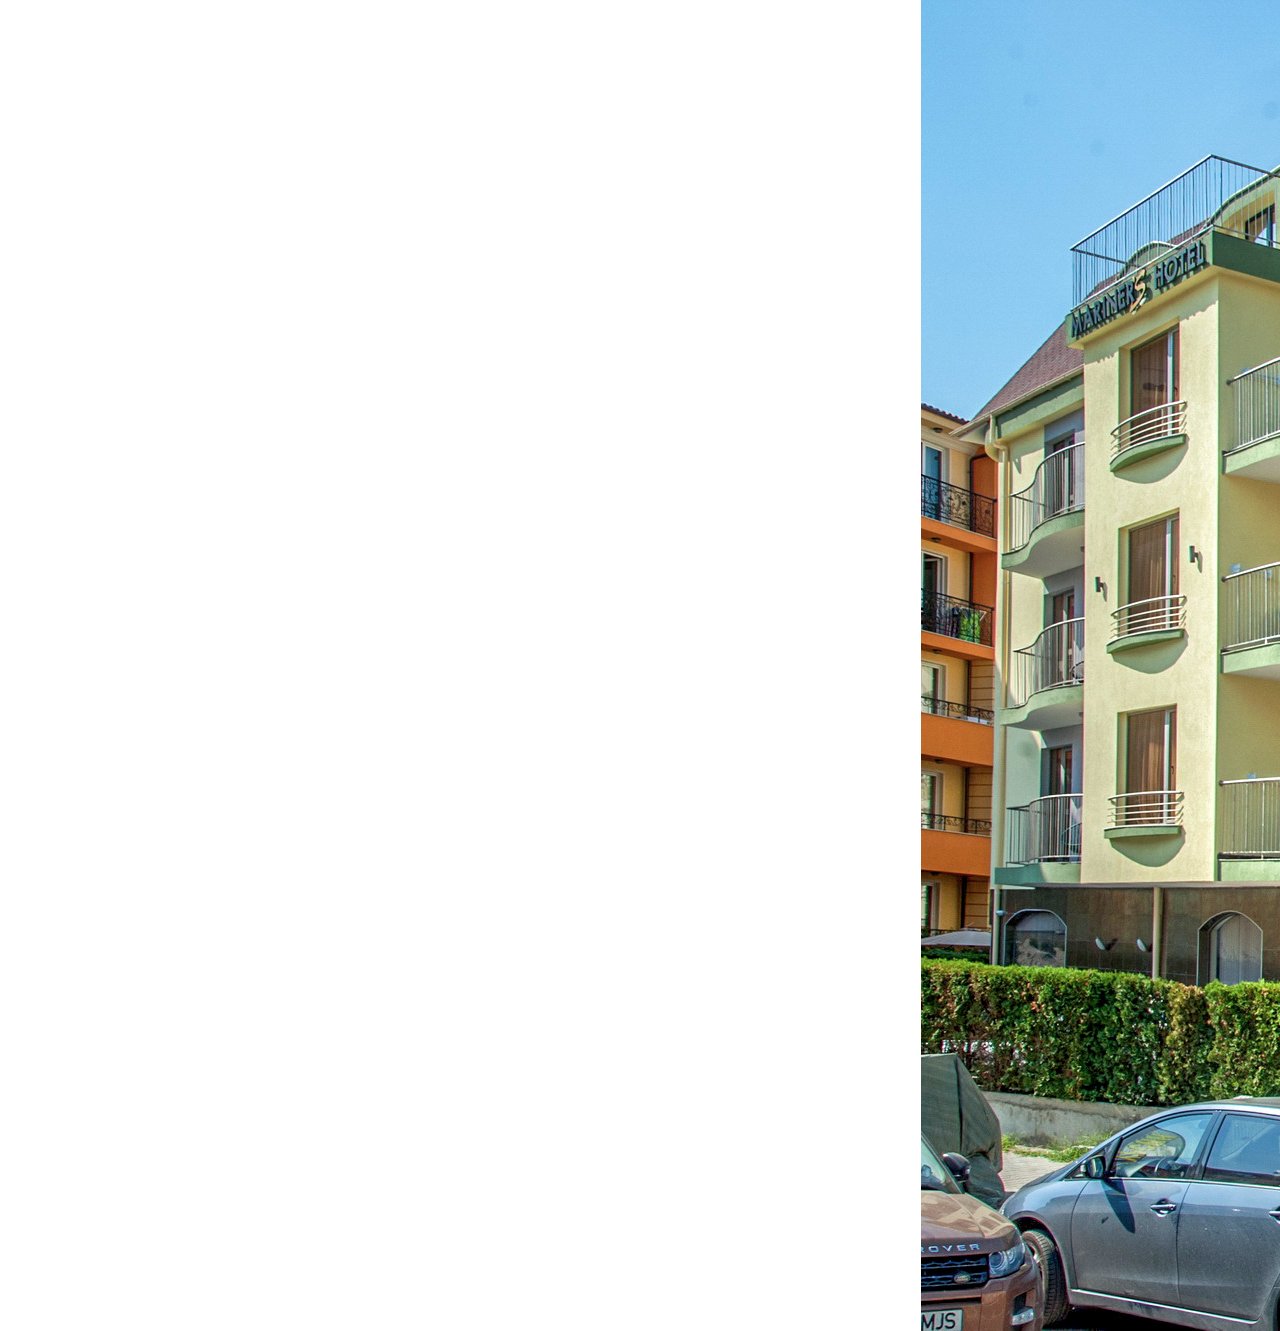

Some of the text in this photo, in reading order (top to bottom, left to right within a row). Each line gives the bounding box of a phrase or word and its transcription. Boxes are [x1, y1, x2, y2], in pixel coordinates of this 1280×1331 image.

[1071, 240, 1205, 338] MARINER'S HOTEL
[921, 1312, 956, 1331] MJS
